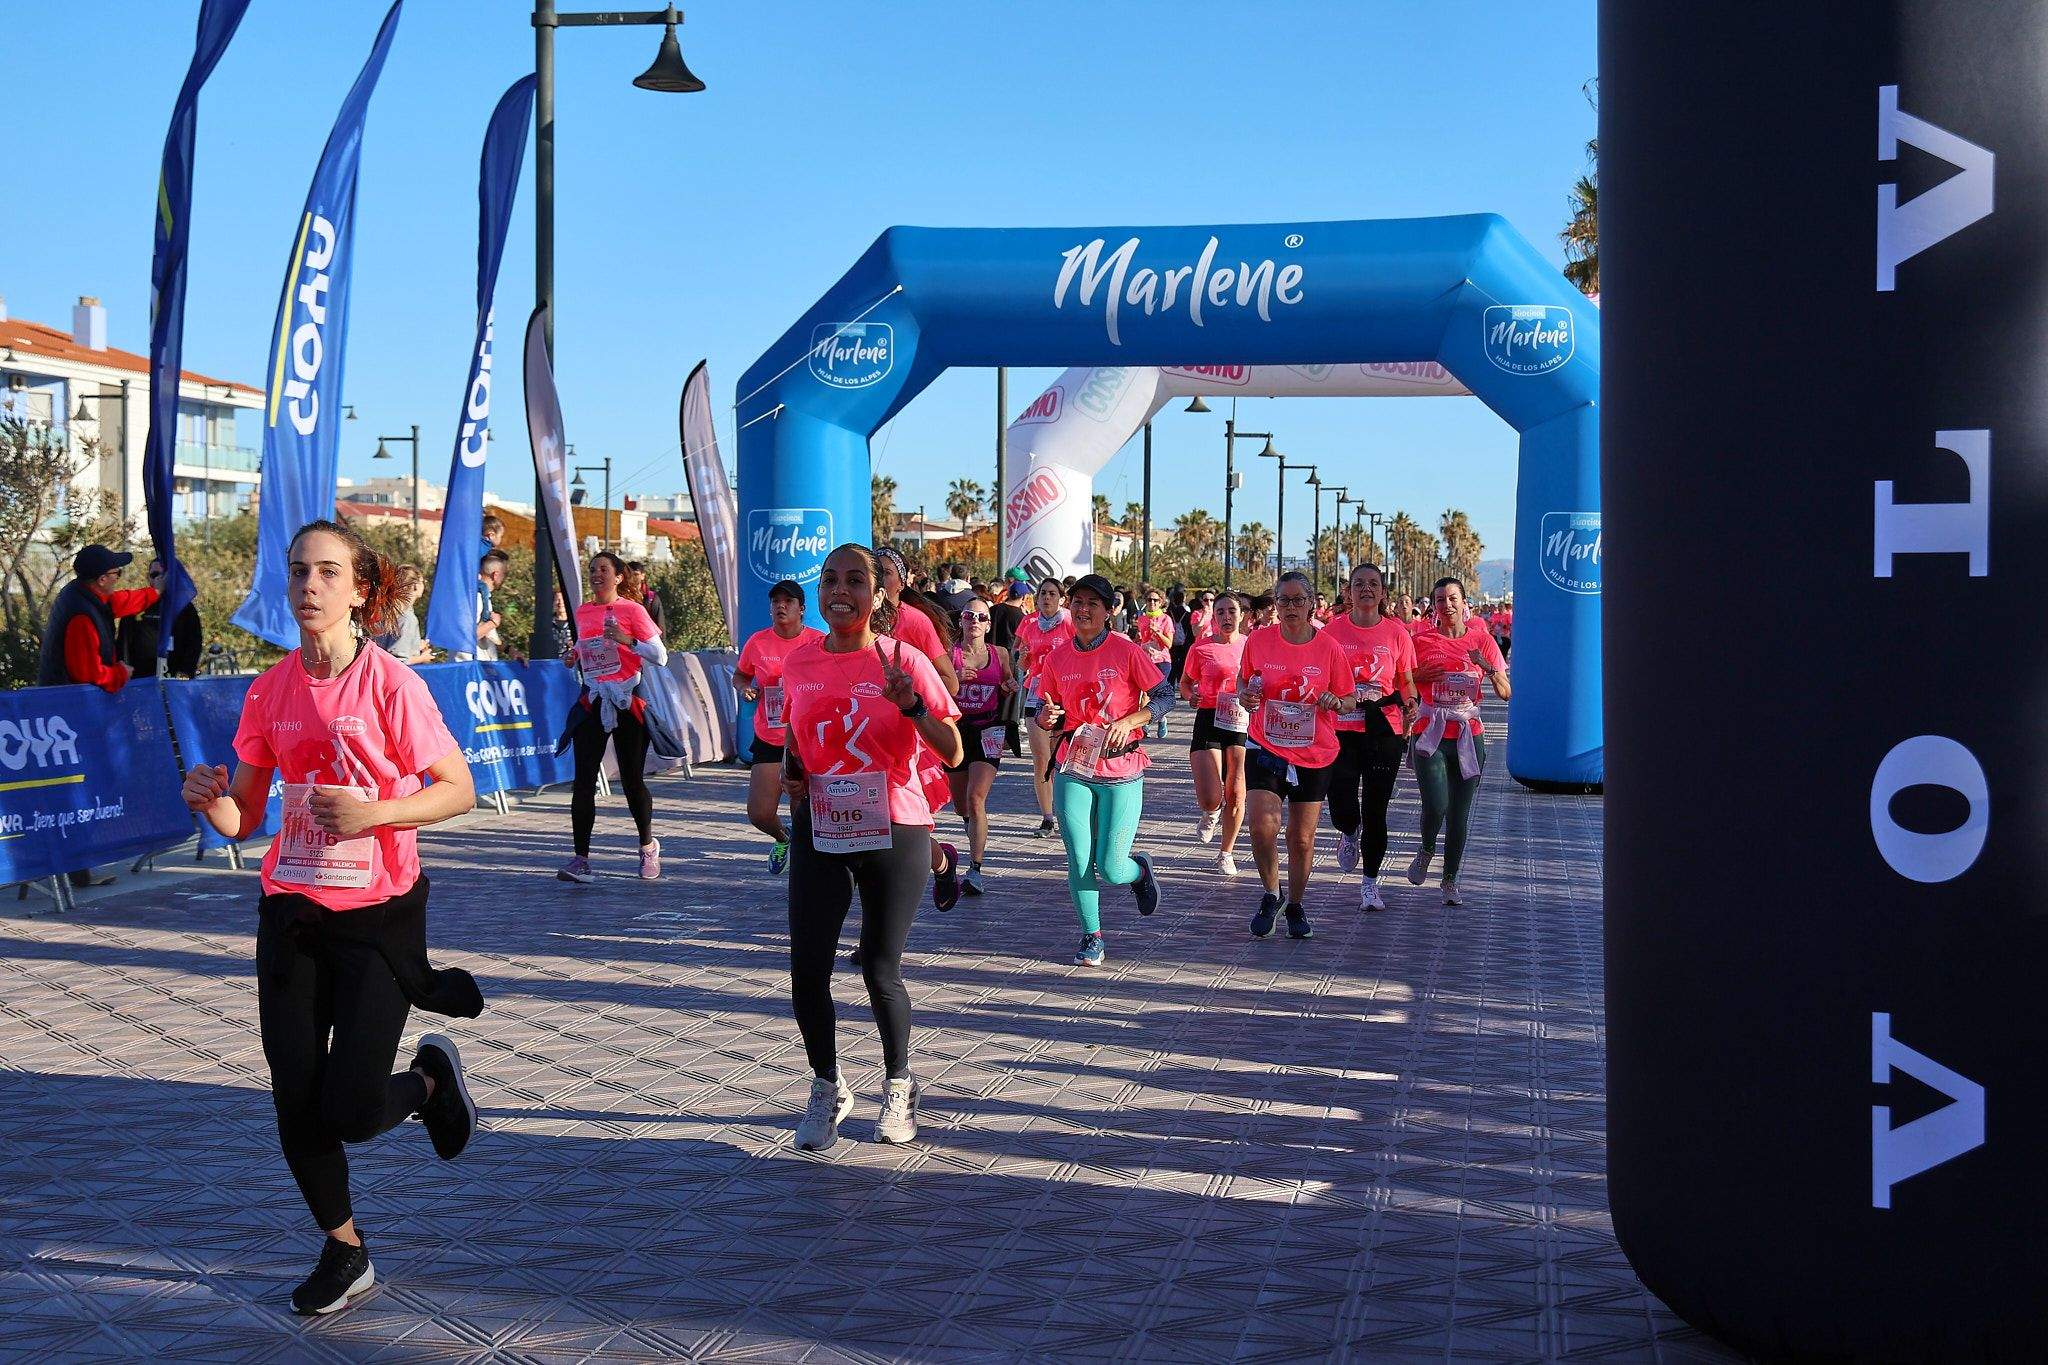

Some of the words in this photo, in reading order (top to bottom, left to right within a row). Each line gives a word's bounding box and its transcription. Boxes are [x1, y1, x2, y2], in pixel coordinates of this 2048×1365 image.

[1054, 235, 1303, 346] Marlene
[1490, 320, 1568, 357] Marlene
[814, 337, 887, 370] Marlene
[1495, 355, 1510, 367] HIJA
[1540, 355, 1562, 370] ALPES
[817, 368, 832, 381] HIJA
[833, 376, 844, 384] DE
[860, 369, 882, 383] ALPES
[752, 526, 827, 565] Marlene
[1546, 530, 1601, 571] Marl
[755, 563, 769, 576] HIJA
[769, 572, 780, 580] DE
[798, 563, 821, 579] ALPES
[1549, 568, 1566, 584] HIJA
[1567, 579, 1579, 588] DE
[1580, 581, 1598, 589] LOS
[466, 679, 529, 723] GOYA
[1280, 721, 1301, 731] 016
[58, 811, 75, 839] que
[77, 808, 95, 822] ser
[95, 796, 125, 820] bueno!
[831, 809, 863, 823] 016
[305, 829, 339, 847] 016
[308, 850, 324, 858] 5123
[331, 861, 357, 869] VALENCIA
[323, 873, 358, 881] Santander
